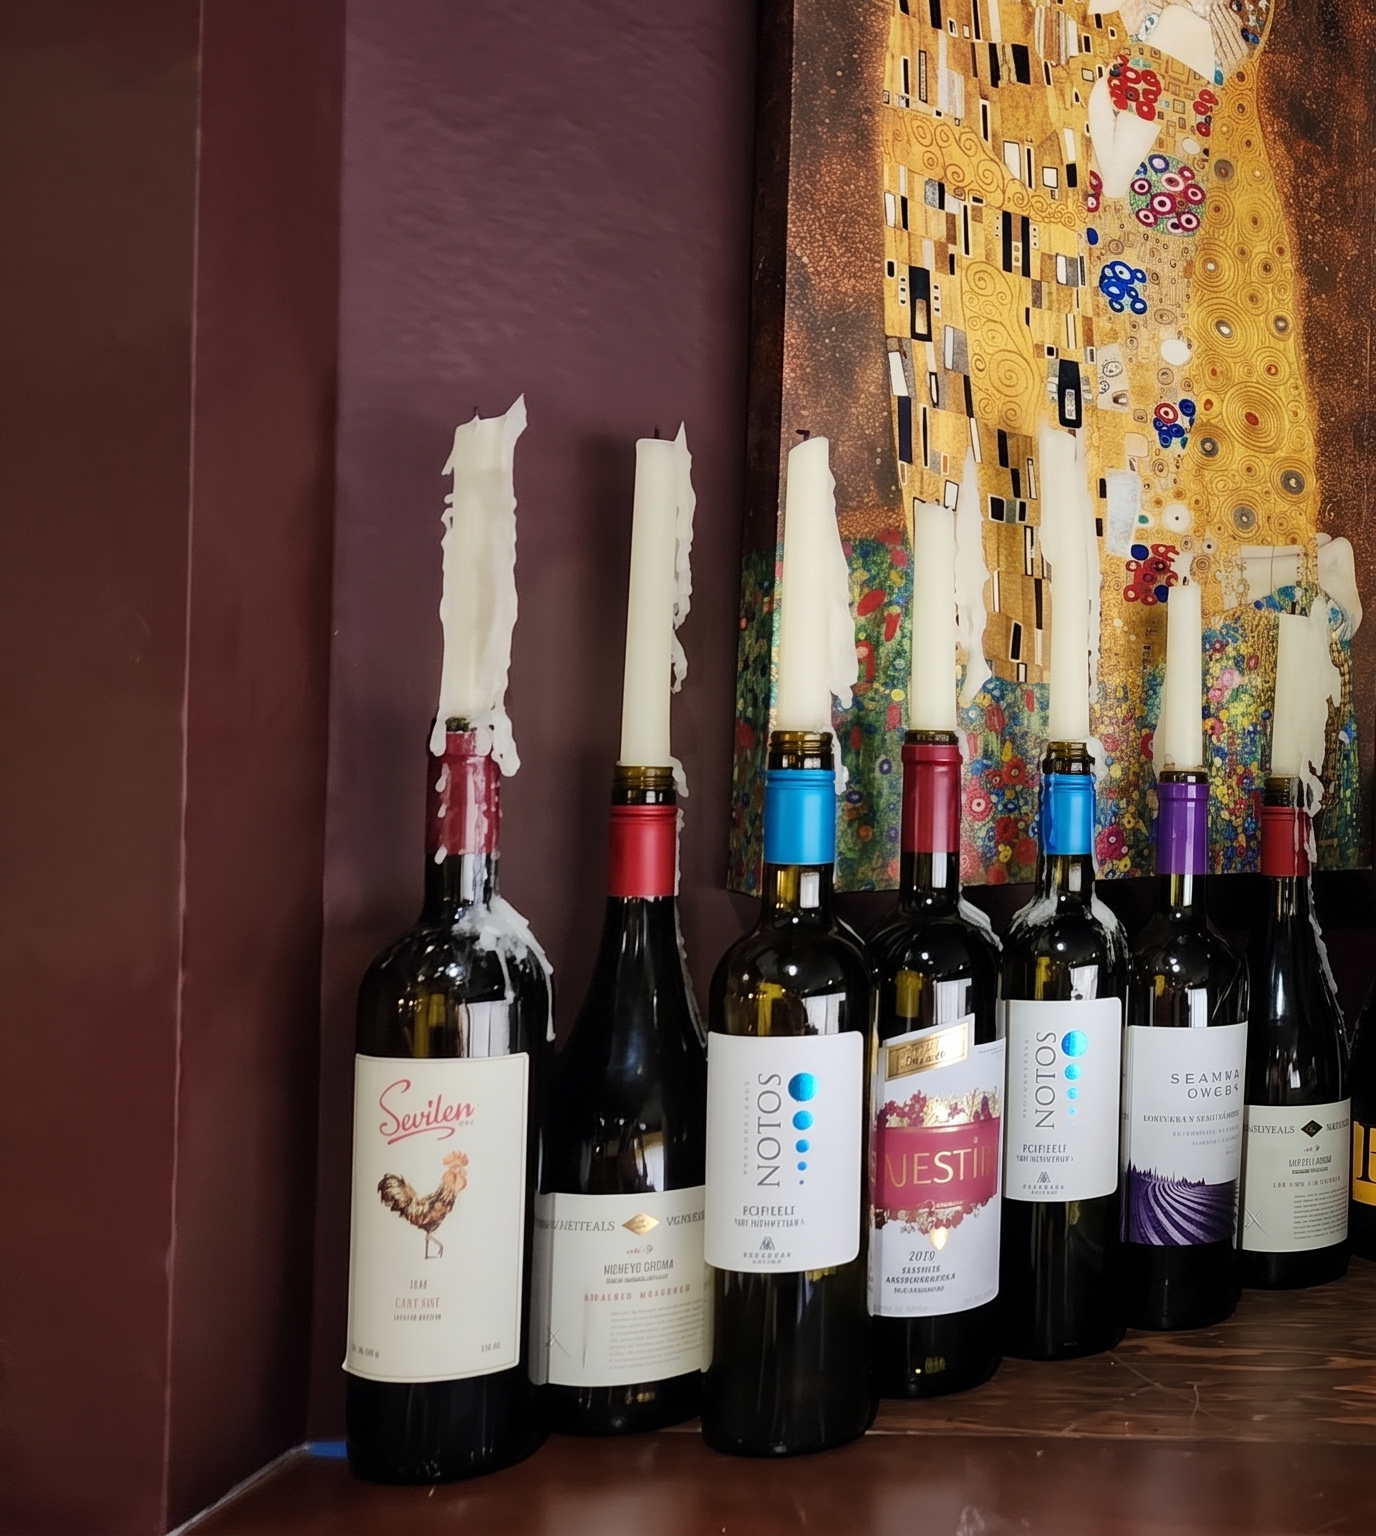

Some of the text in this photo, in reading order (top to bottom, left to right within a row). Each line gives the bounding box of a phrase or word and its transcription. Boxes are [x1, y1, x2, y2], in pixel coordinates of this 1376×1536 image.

[379, 1079, 475, 1138] Sevilen
[1035, 1032, 1057, 1130] NOTOS
[757, 1073, 782, 1188] NOTOS
